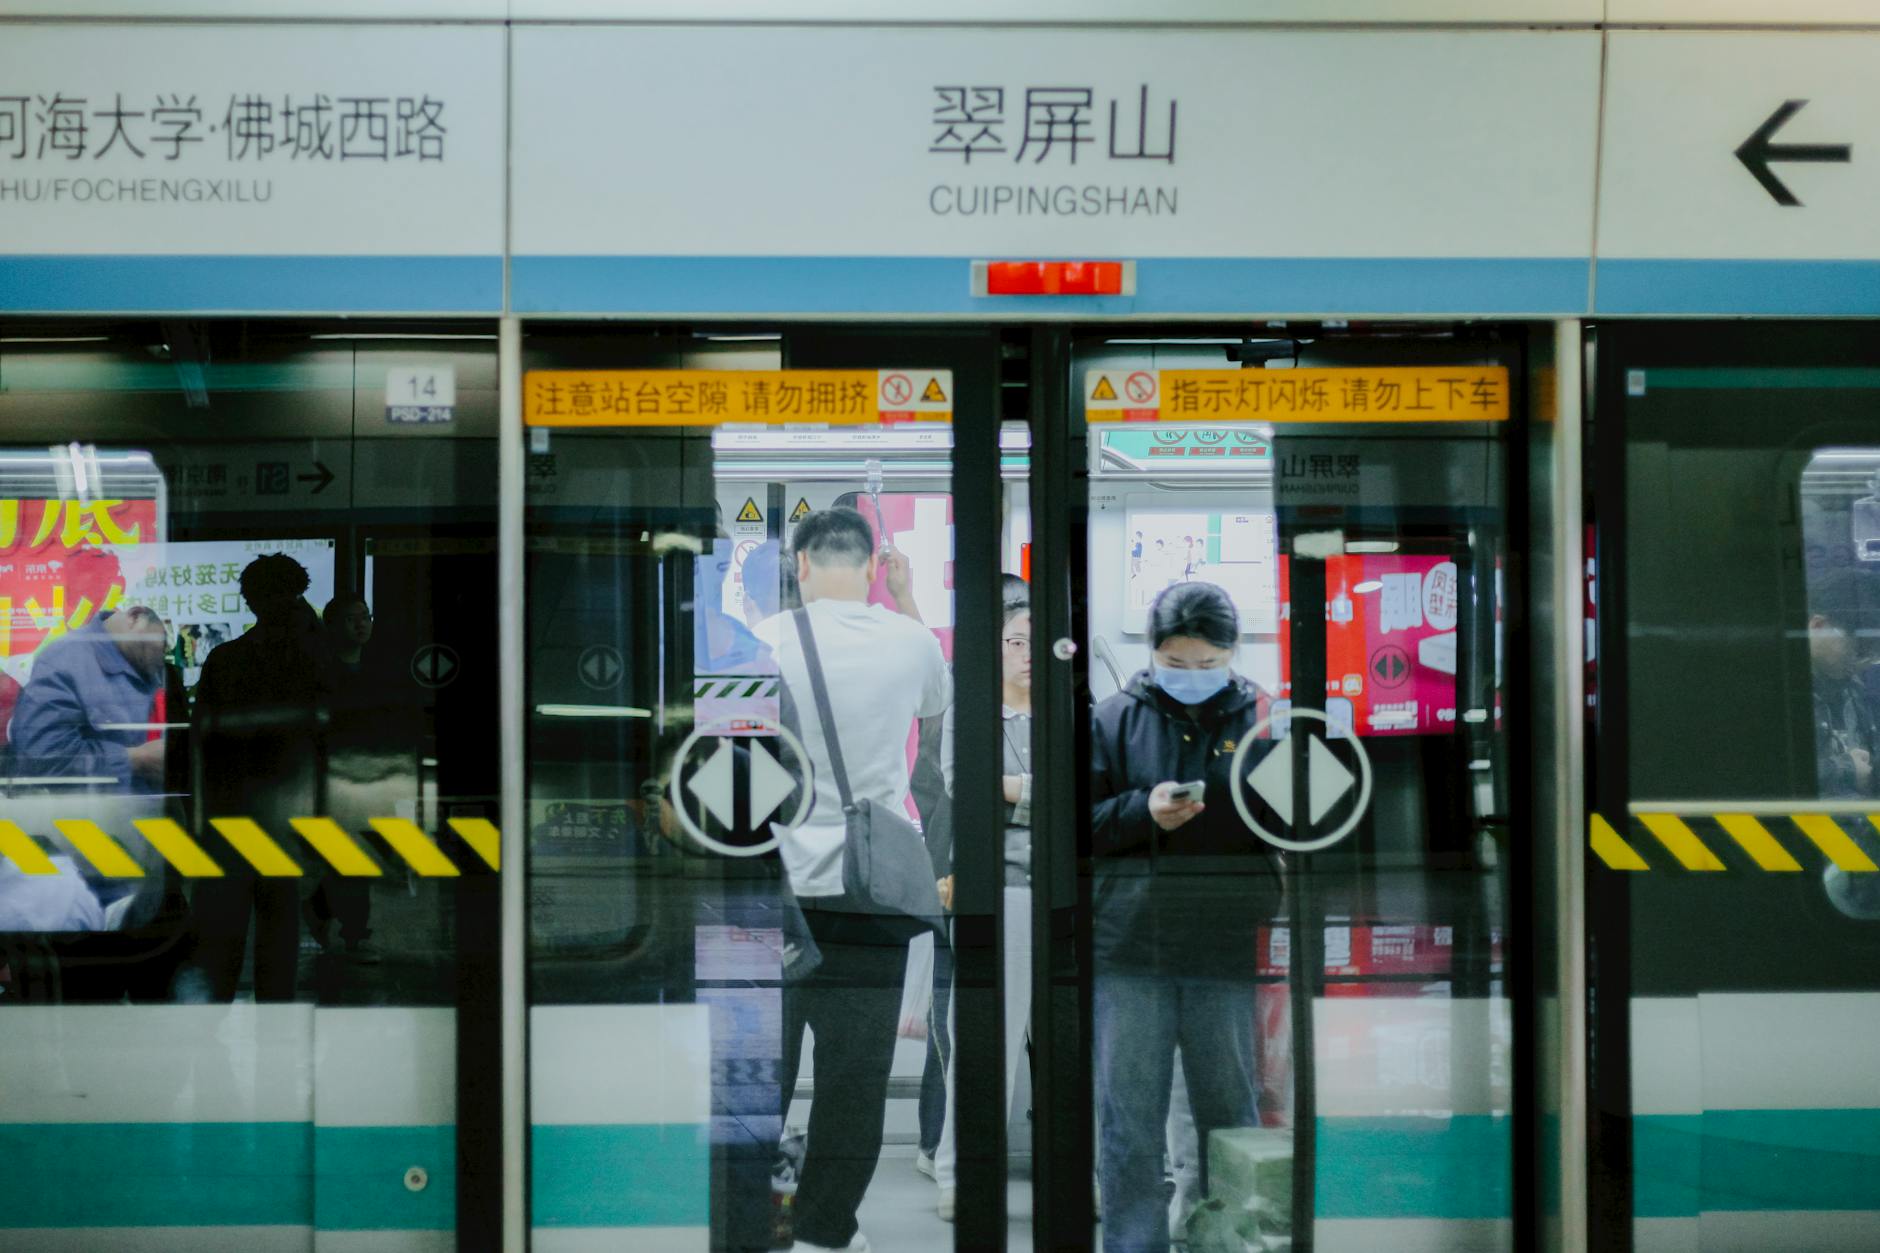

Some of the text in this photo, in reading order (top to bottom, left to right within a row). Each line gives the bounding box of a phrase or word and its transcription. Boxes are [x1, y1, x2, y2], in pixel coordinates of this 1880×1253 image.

[928, 83, 1178, 165] 翠屏山
[929, 185, 1178, 216] CUIPINGSHAN
[408, 375, 437, 400] 14
[535, 379, 870, 416] 注意站台空隙 请勿拥挤
[1170, 376, 1501, 413] 指示灯闪烁 请勿上下车
